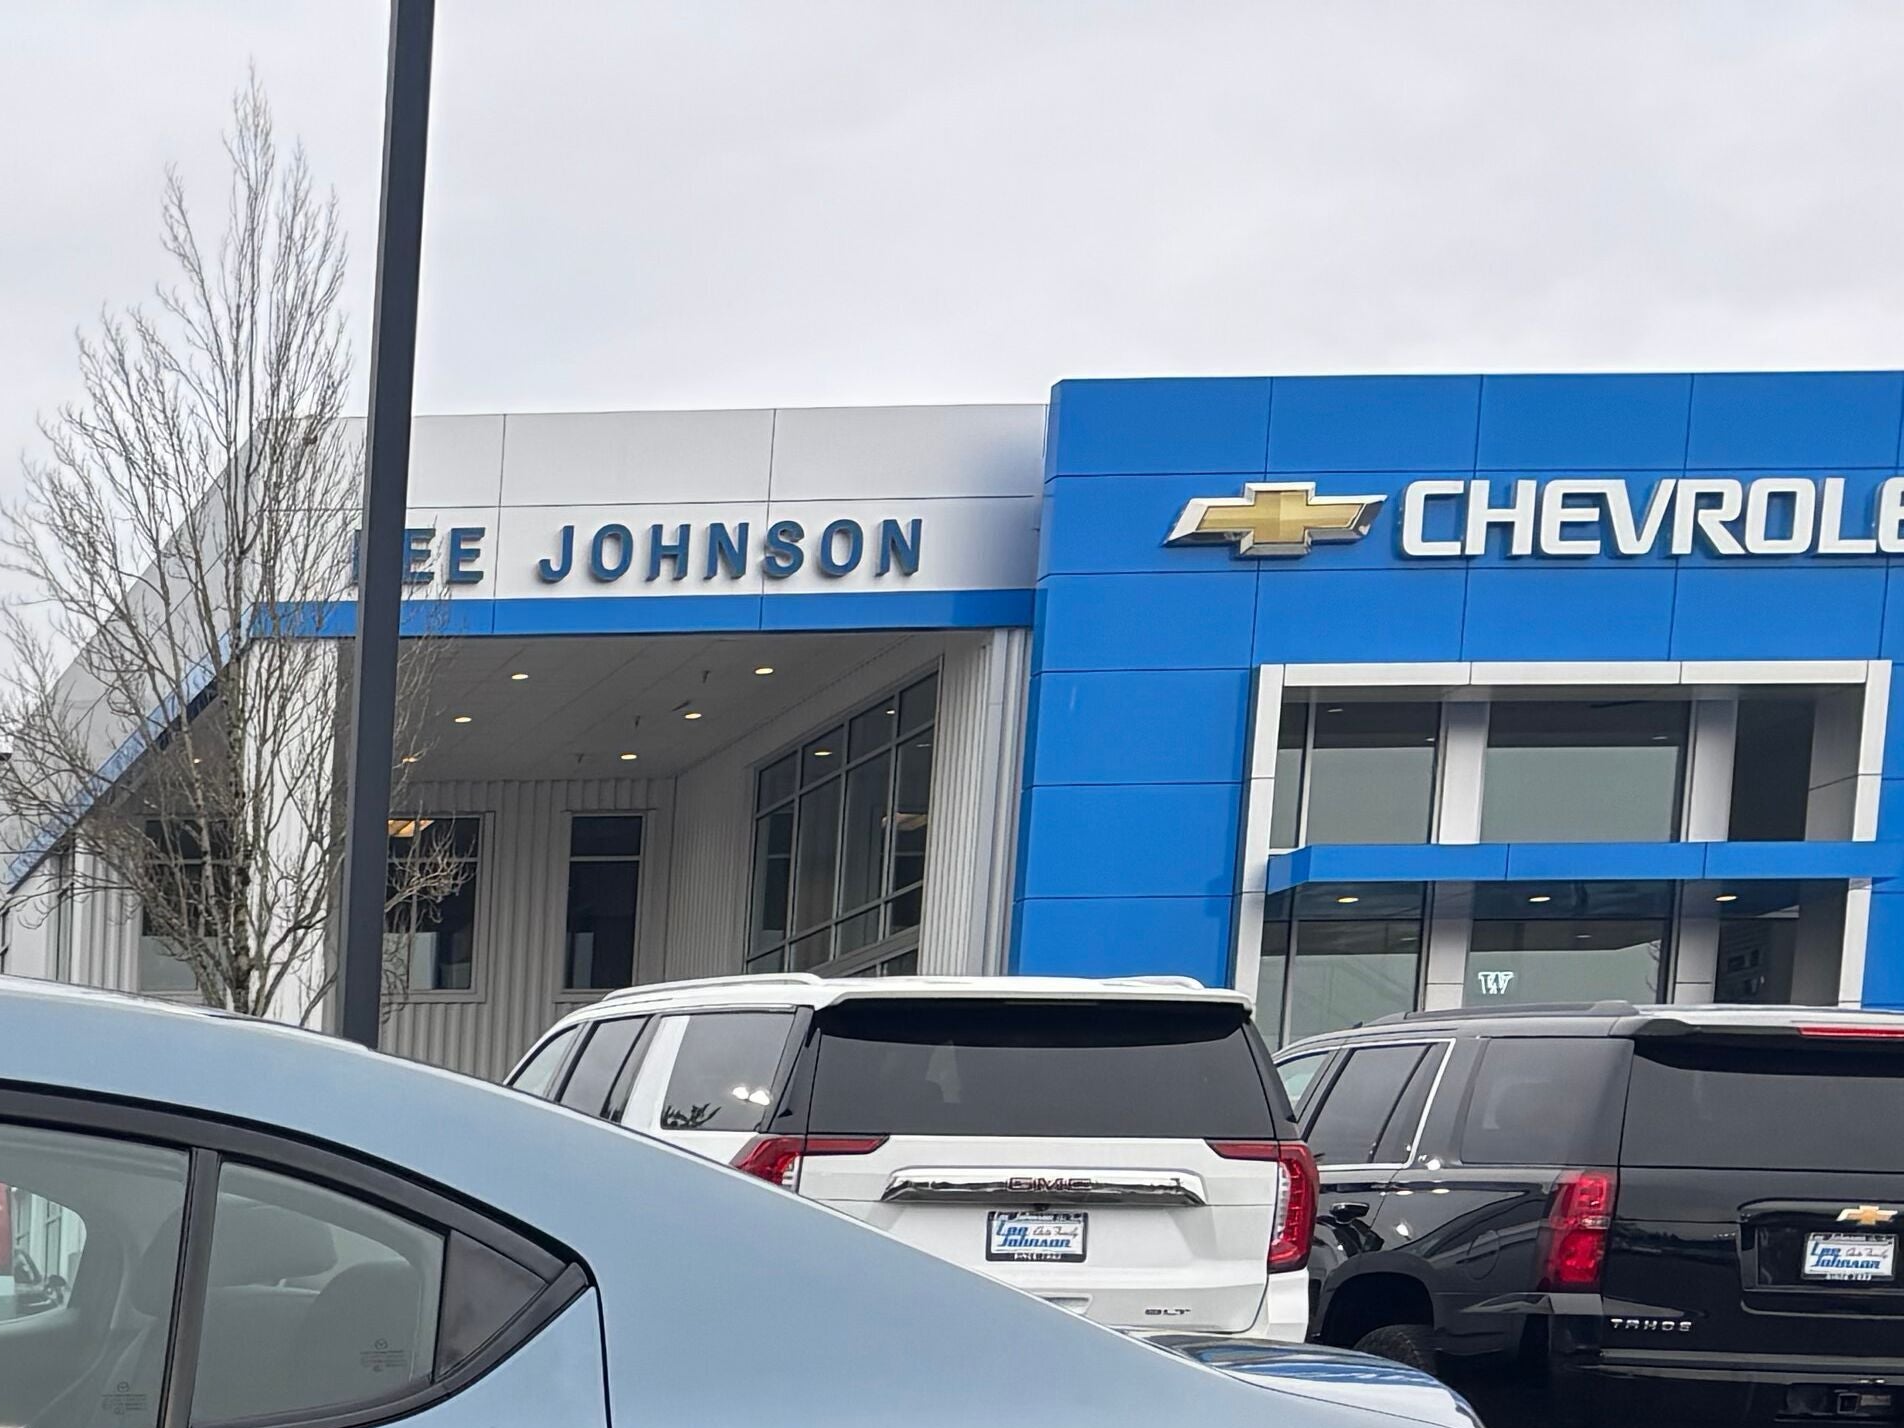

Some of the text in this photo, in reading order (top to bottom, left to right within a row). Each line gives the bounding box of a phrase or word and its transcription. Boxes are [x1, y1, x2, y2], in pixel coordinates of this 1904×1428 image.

[354, 517, 924, 585] EE JOHNSON
[1007, 1177, 1093, 1192] GMC
[1610, 1318, 1692, 1332] TAHOE
